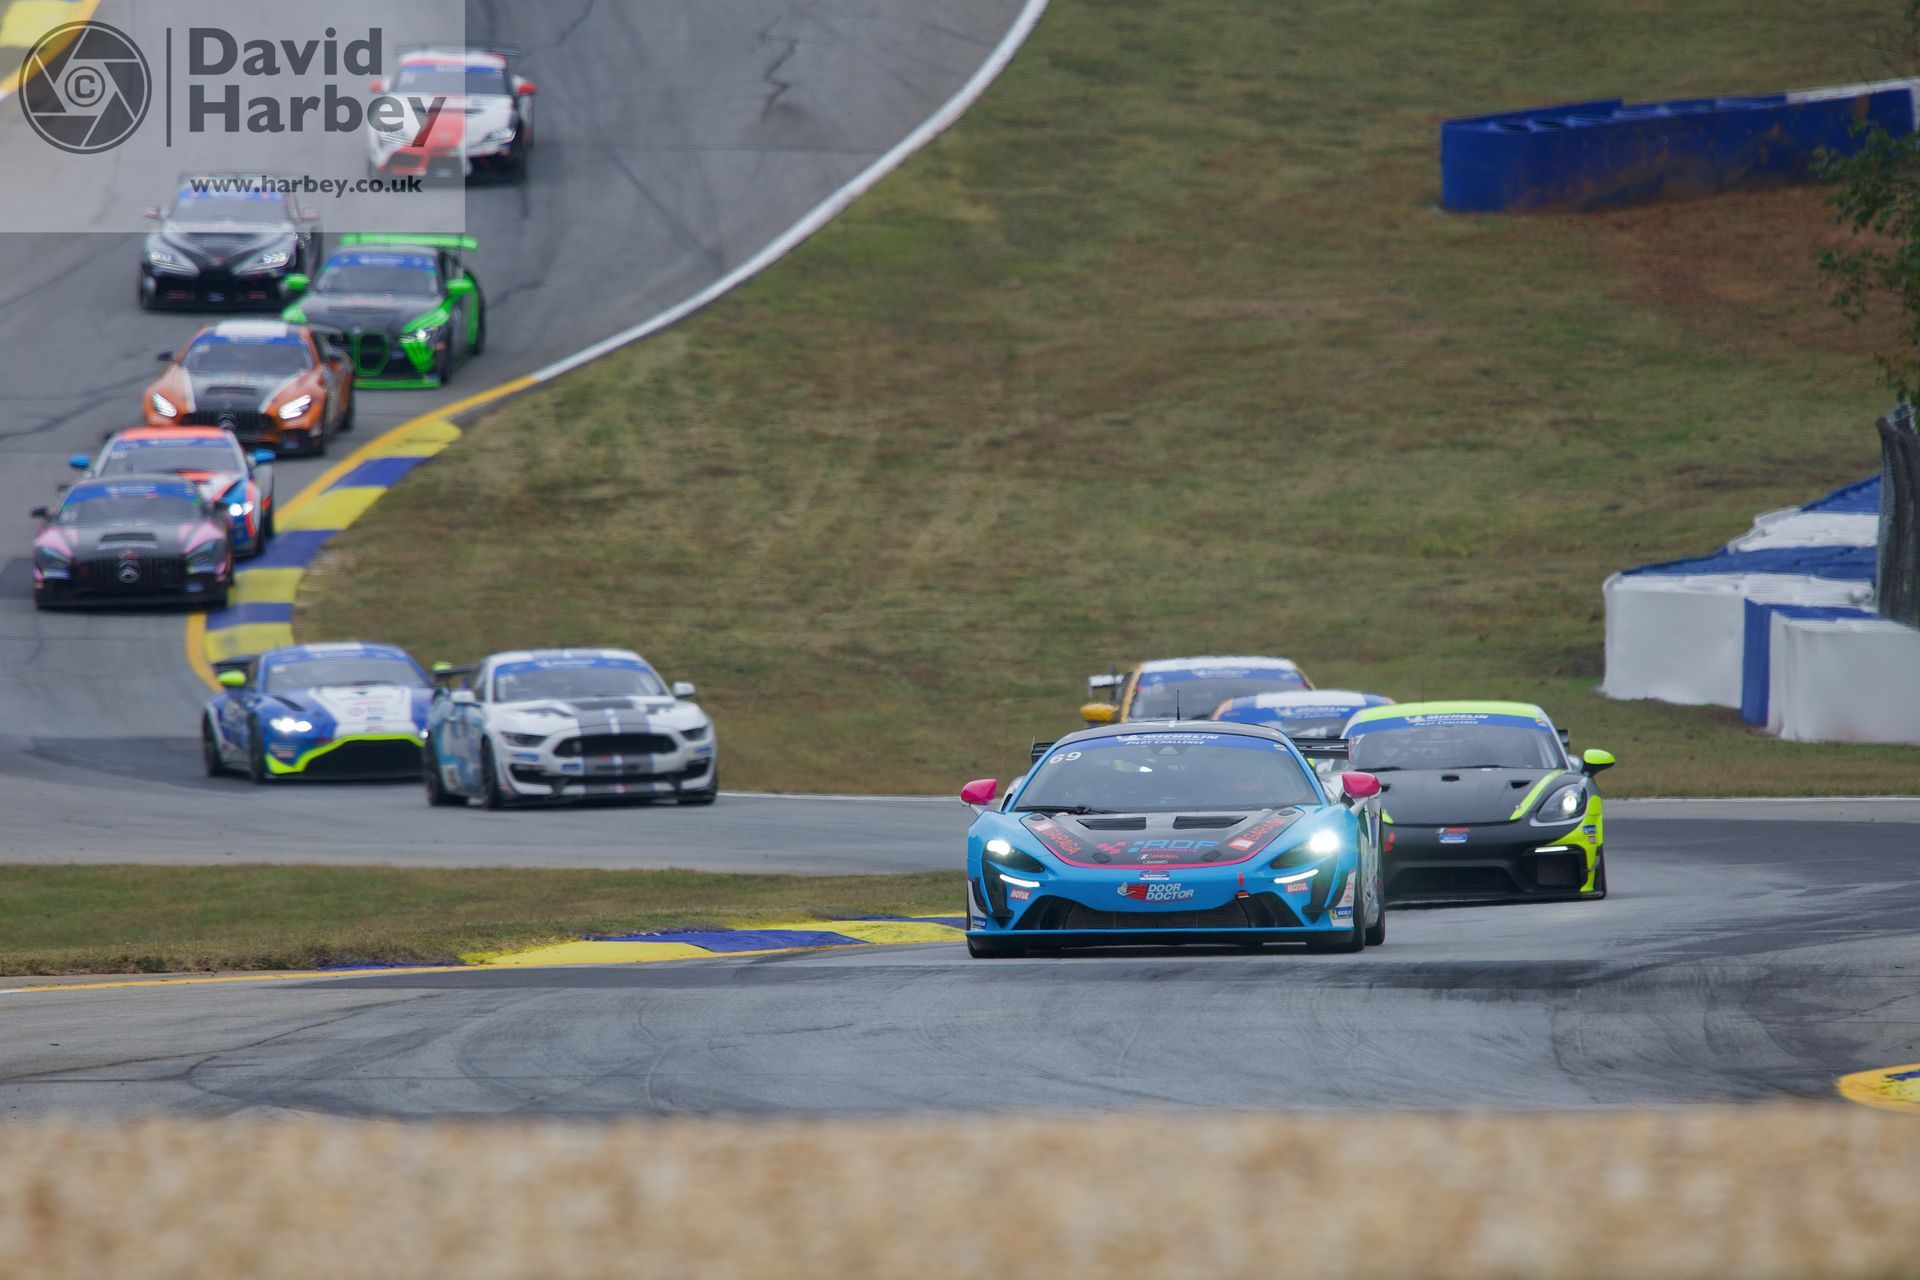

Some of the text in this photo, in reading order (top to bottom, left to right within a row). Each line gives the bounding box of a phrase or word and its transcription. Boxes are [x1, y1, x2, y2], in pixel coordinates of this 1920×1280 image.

[1142, 733, 1220, 741] MICHELIN
[1049, 751, 1082, 764] 69
[1148, 883, 1181, 892] DOOR
[1146, 889, 1195, 900] DOCTOR
